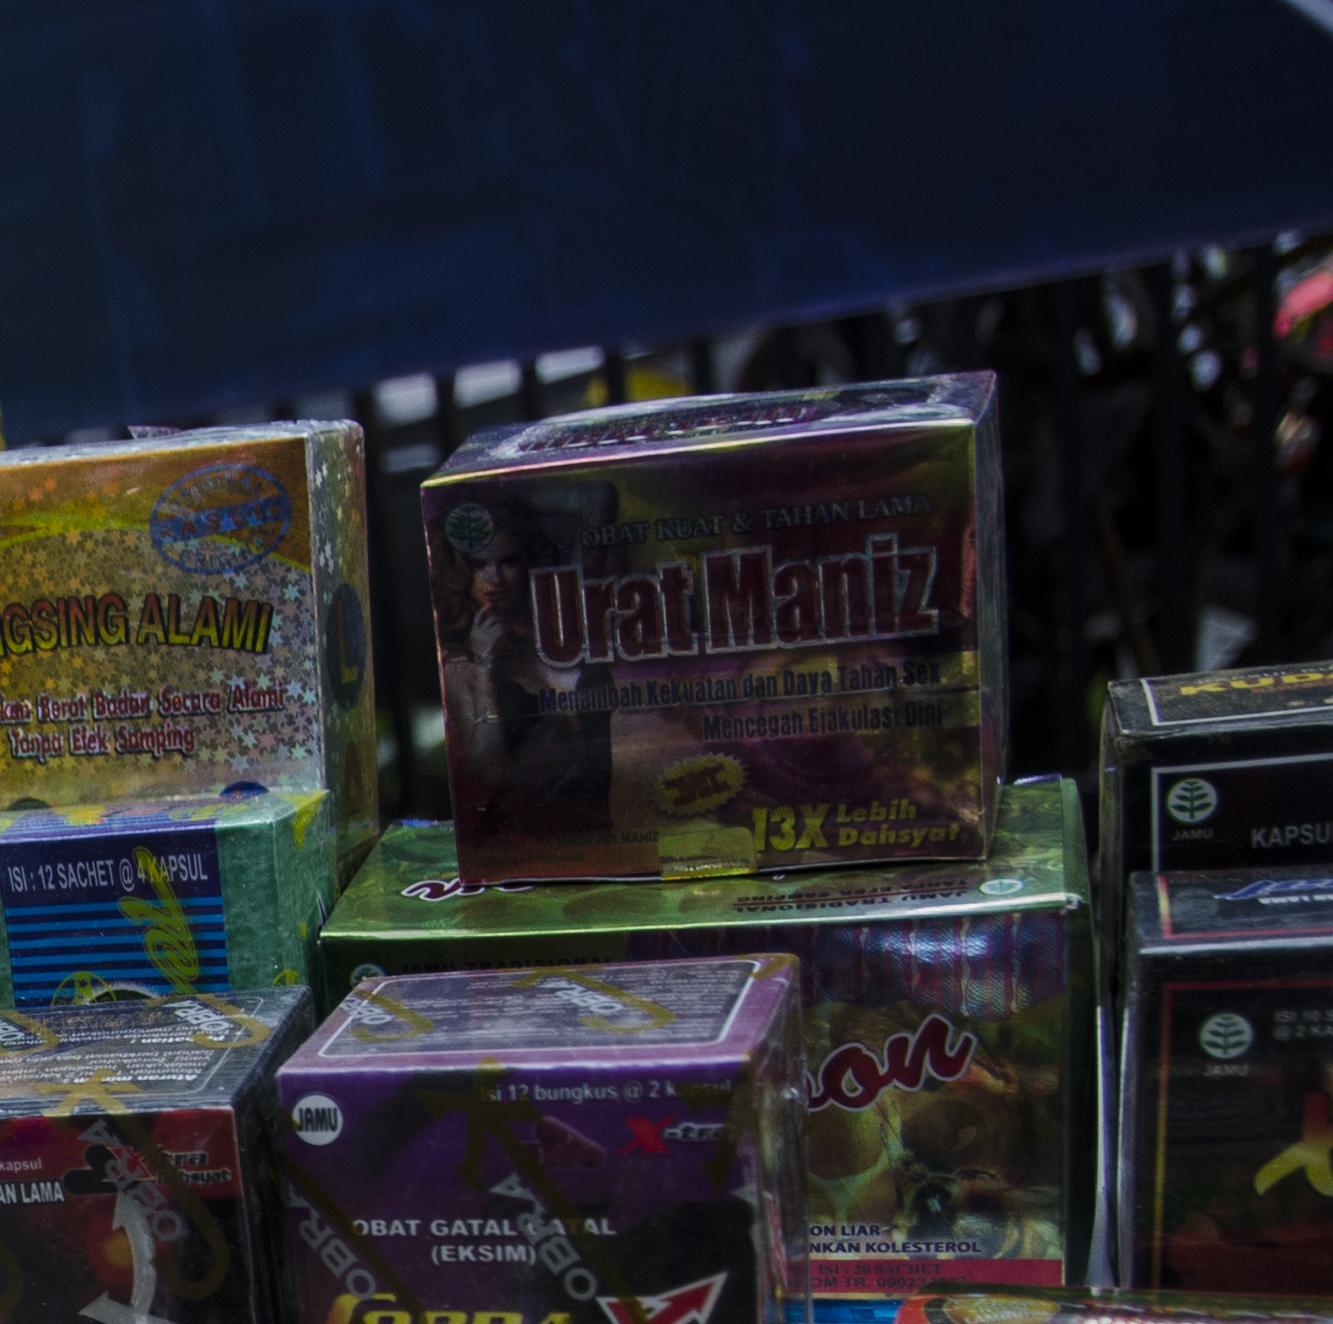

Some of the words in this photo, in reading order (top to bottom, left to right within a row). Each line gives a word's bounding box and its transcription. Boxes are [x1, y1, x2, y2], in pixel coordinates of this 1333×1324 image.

[581, 521, 649, 549] OBAT
[656, 515, 727, 542] KUAT
[732, 512, 753, 535] &
[760, 503, 852, 530] TAHAN
[858, 493, 933, 523] LAMA
[529, 560, 700, 672] Urat
[698, 532, 941, 655] Maniz
[136, 593, 274, 655] ALAMI
[38, 694, 88, 723] Berat
[93, 692, 154, 721] Badan
[158, 687, 223, 718] Secara
[227, 680, 285, 713] Alami
[703, 711, 805, 744] Mencegah
[808, 704, 901, 739] Ejakulasi
[904, 701, 945, 728] Dini
[9, 731, 64, 764] Tanpa
[68, 727, 108, 757] Efek
[114, 722, 196, 758] Samping
[752, 801, 830, 854] 13X
[834, 798, 917, 827] Lebih
[295, 1105, 340, 1134] JAMU
[20, 1180, 67, 1204] LAMA
[351, 1220, 422, 1239] OBAT
[430, 1219, 518, 1239] GATAL
[839, 1223, 881, 1238] LIAR
[431, 1244, 537, 1266] (EKSIM)
[864, 1239, 983, 1255] KOLESTEROL
